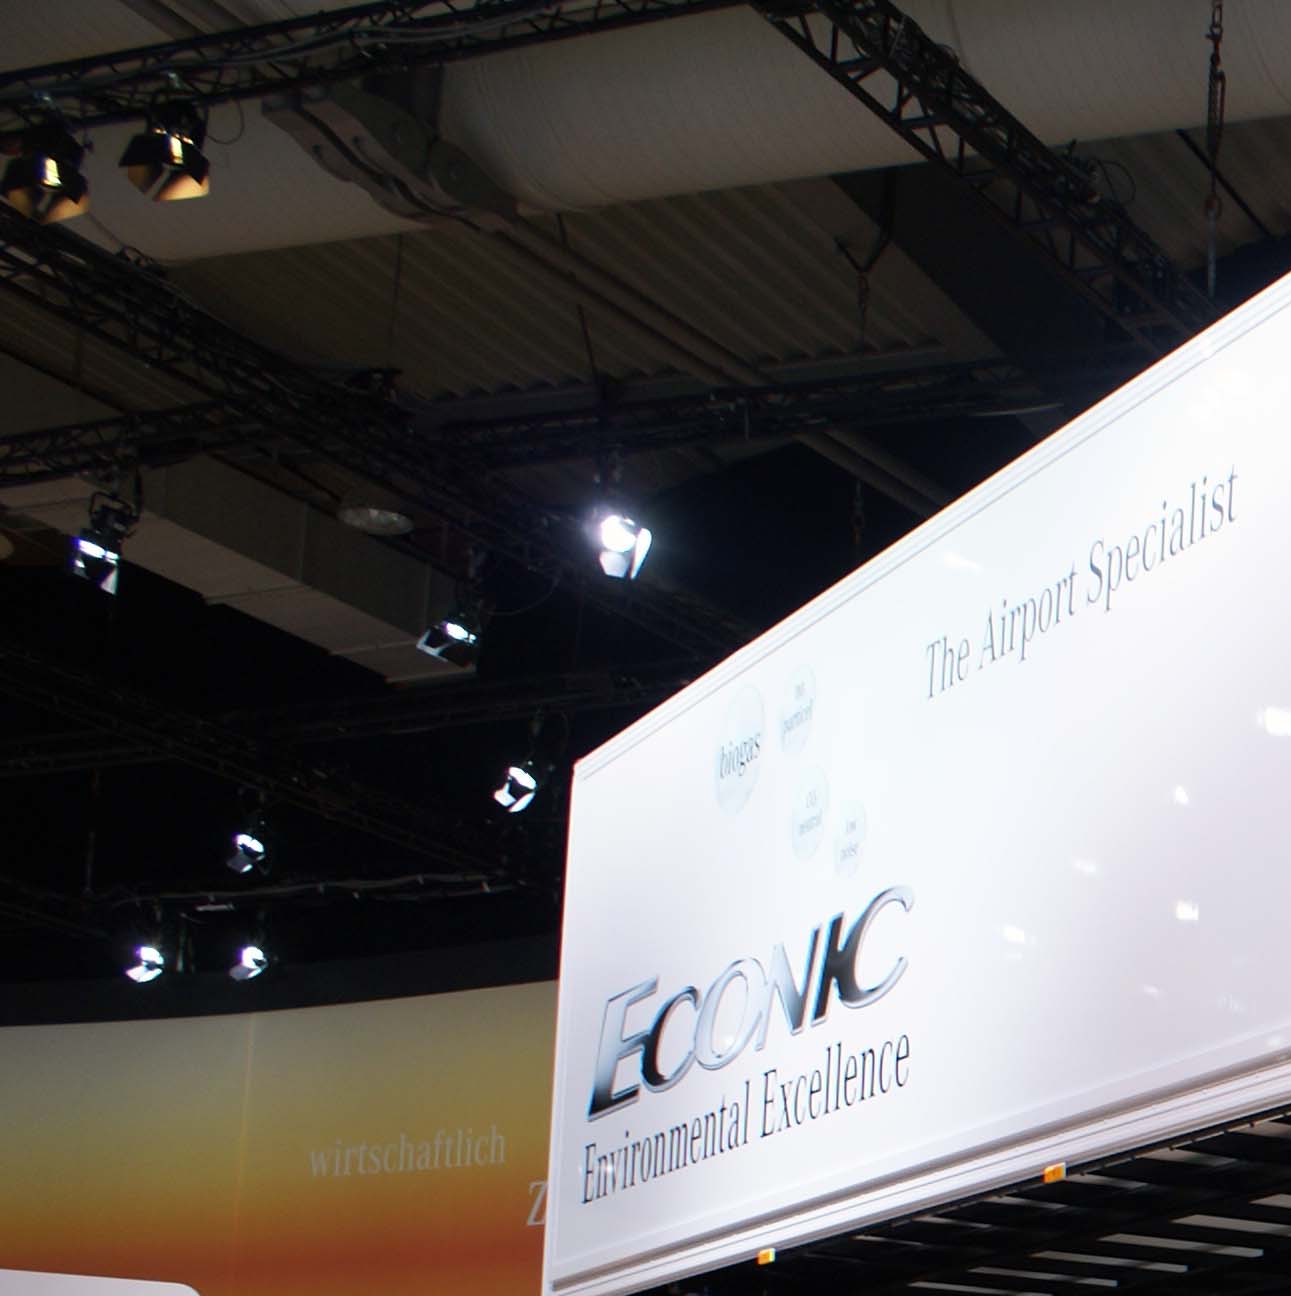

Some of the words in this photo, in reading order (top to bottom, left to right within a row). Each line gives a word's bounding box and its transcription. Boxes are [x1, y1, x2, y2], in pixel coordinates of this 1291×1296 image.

[926, 635, 970, 700] The
[977, 561, 1079, 671] Airport
[1087, 463, 1239, 613] Specialist
[719, 732, 761, 780] biogas
[309, 1124, 506, 1178] wirtschaftlich
[582, 1080, 749, 1205] Environmental
[760, 1033, 911, 1140] Excellence
